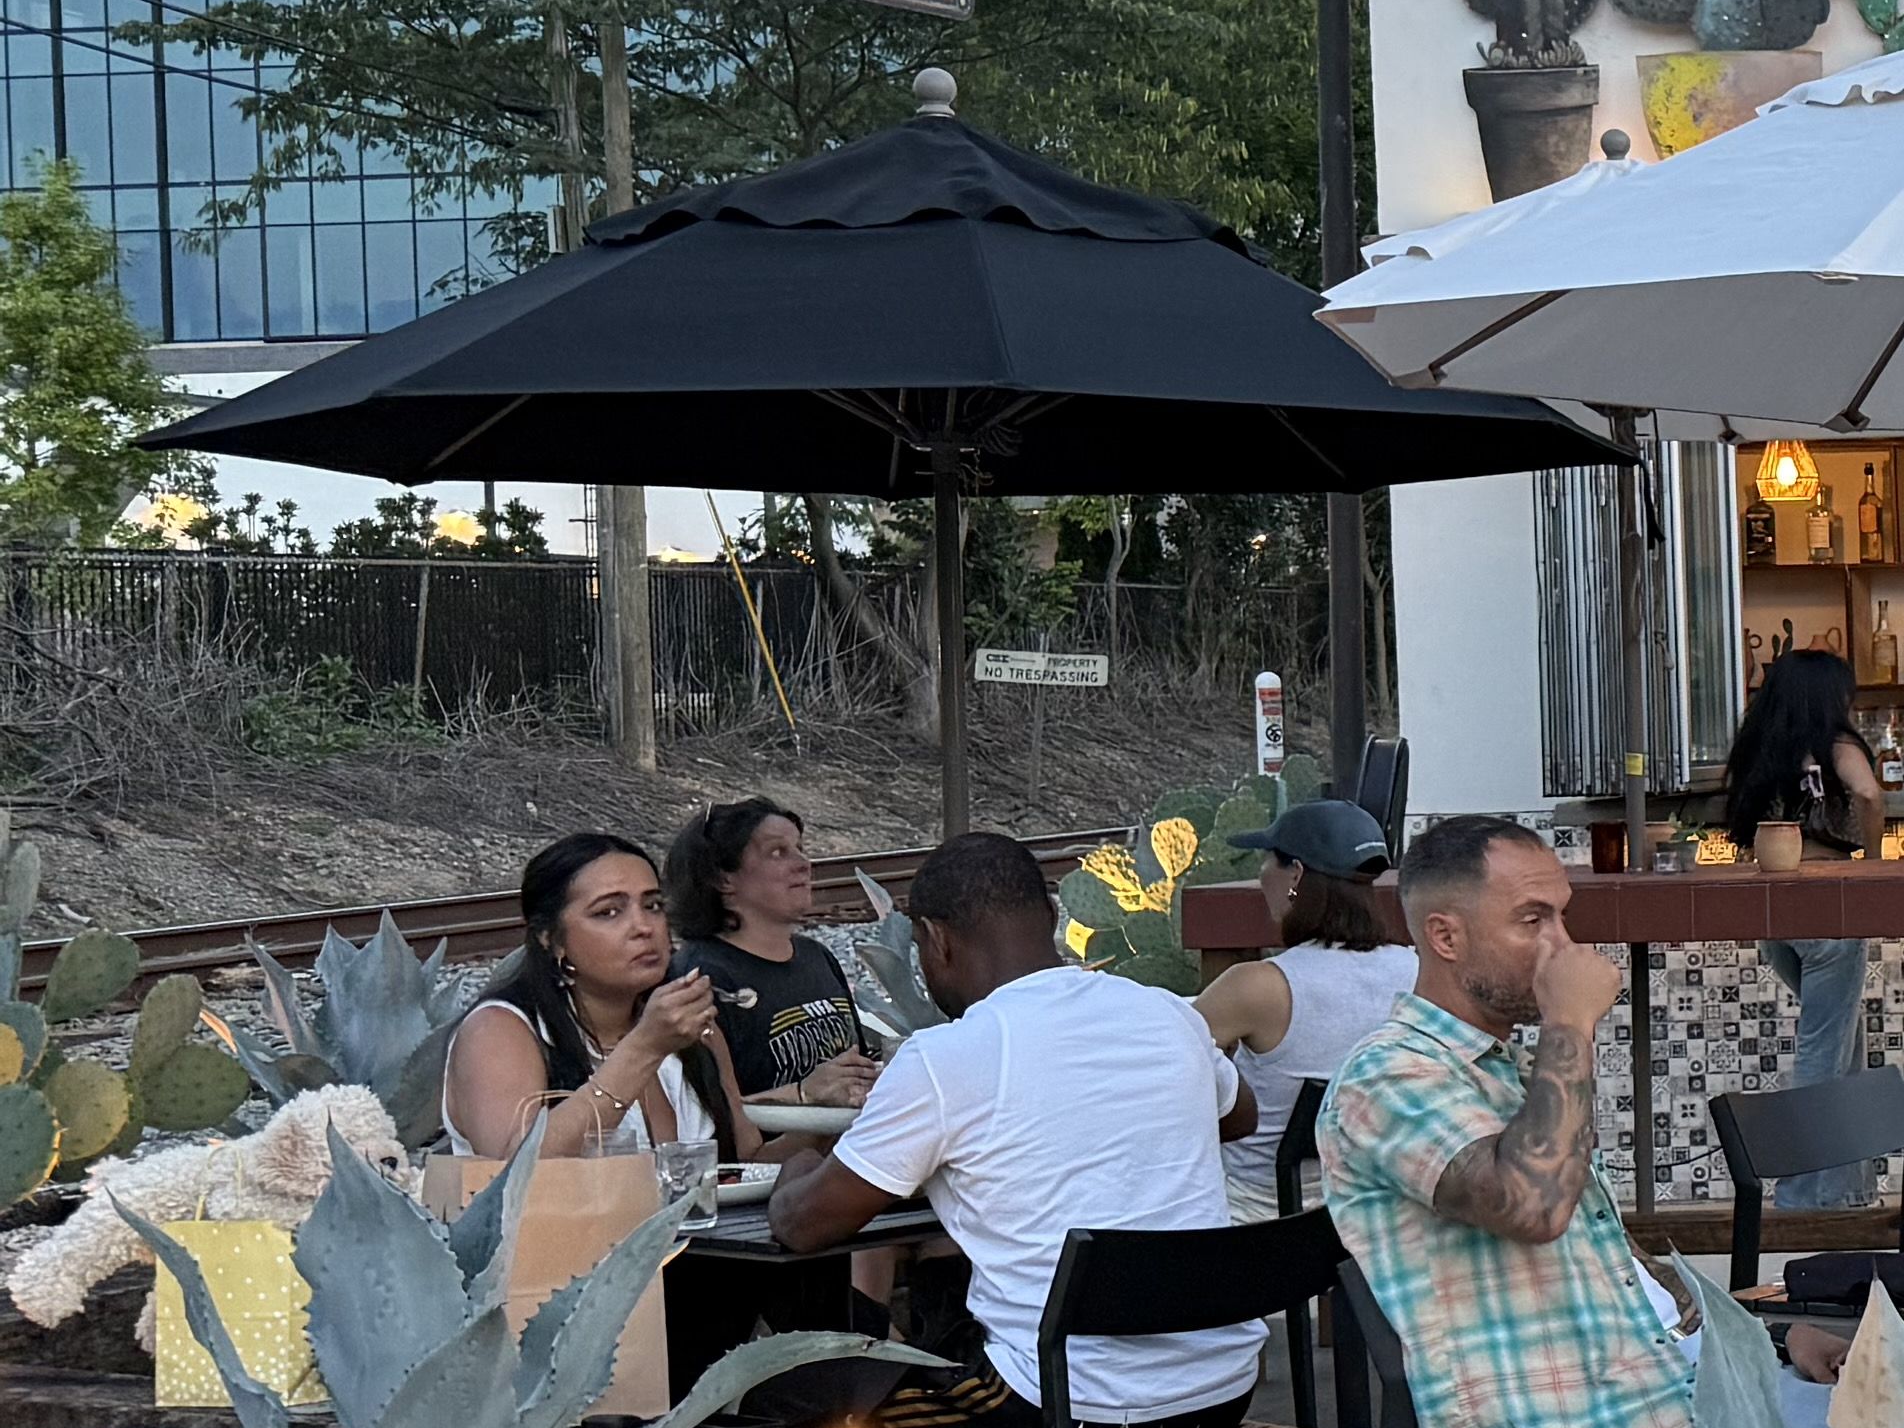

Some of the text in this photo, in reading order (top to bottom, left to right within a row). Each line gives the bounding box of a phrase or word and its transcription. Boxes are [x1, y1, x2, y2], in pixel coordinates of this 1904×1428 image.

[1047, 656, 1099, 669] PROPERTY
[984, 665, 1099, 684] NO TRESPASSING
[802, 999, 838, 1018] FIFA
